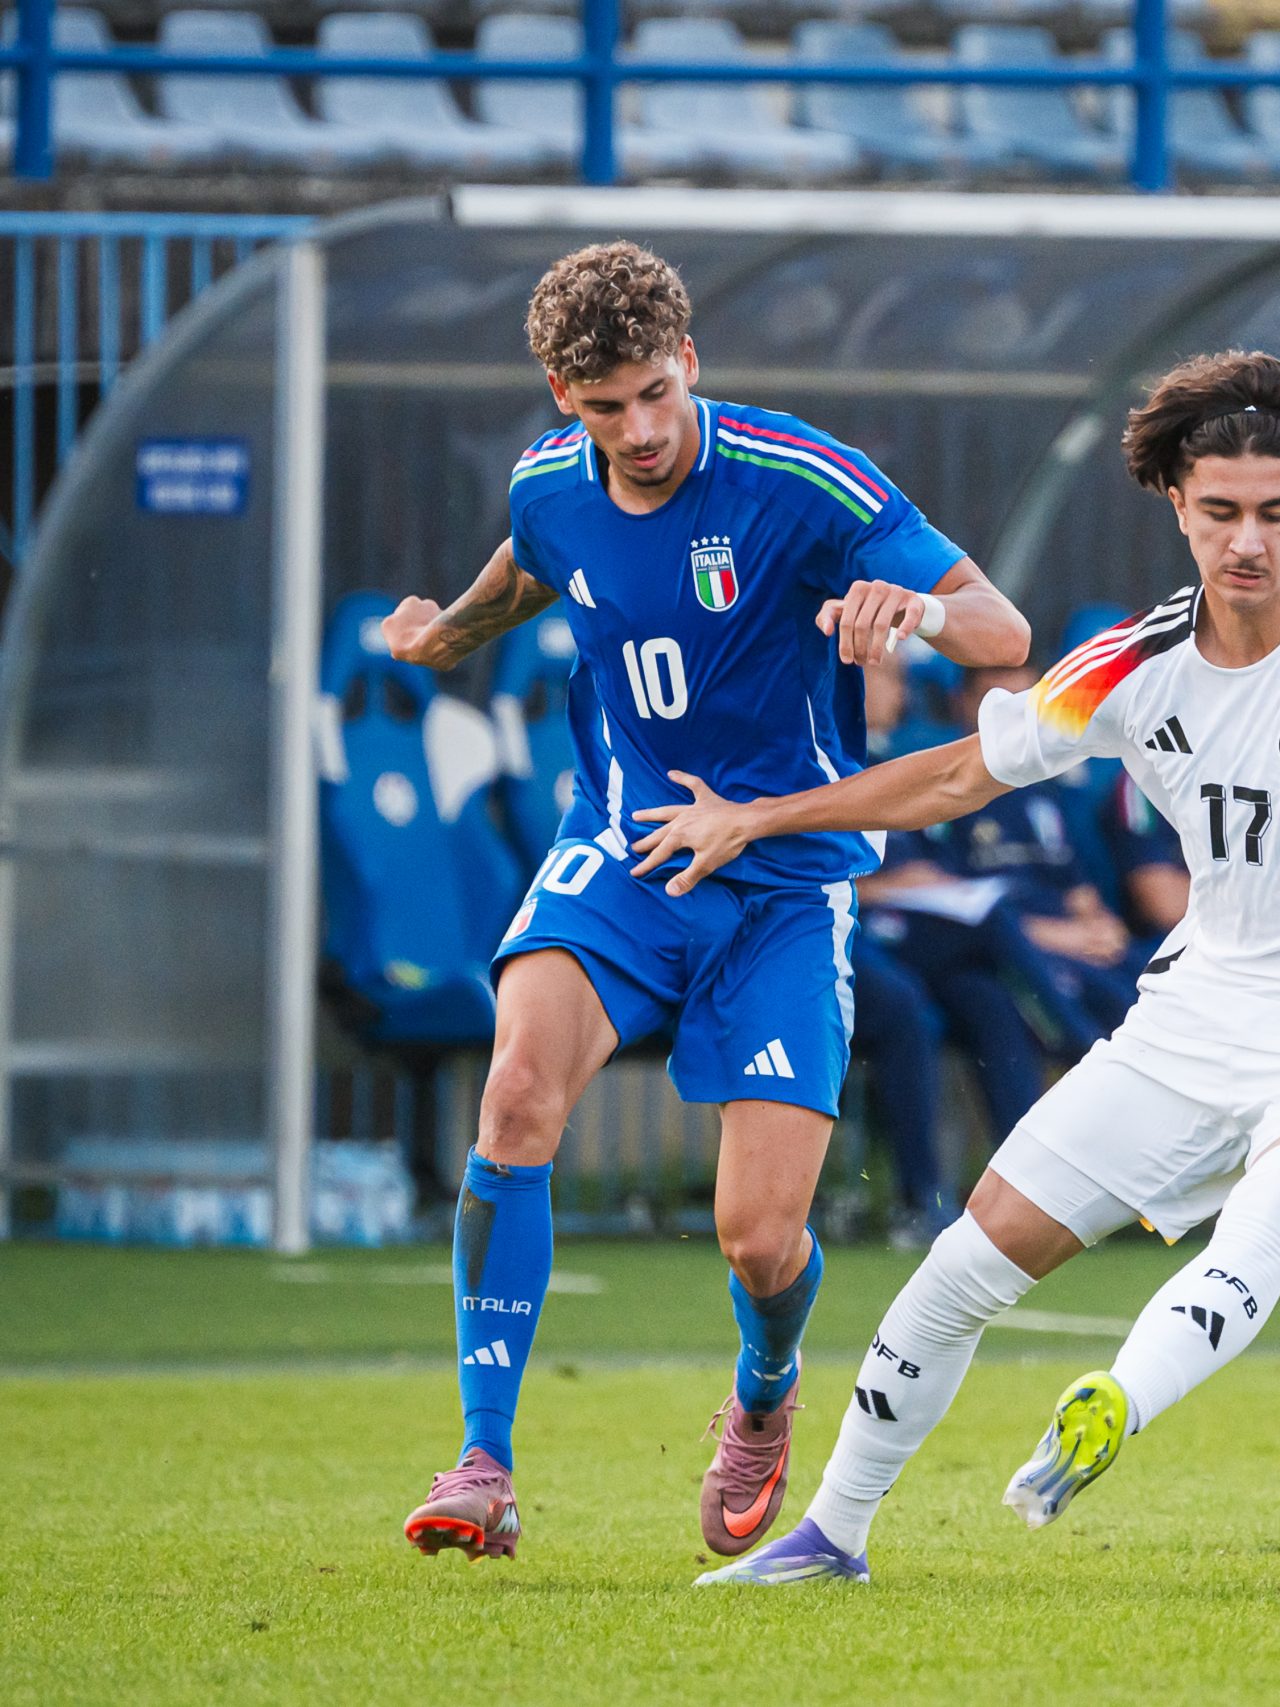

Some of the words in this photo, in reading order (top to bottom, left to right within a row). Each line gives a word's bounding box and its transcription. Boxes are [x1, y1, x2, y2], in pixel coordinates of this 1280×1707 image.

[694, 551, 730, 567] ITALIA
[622, 637, 688, 720] 10
[1200, 783, 1272, 867] 17
[462, 1296, 532, 1316] ITALIA
[1204, 1268, 1258, 1320] DFB
